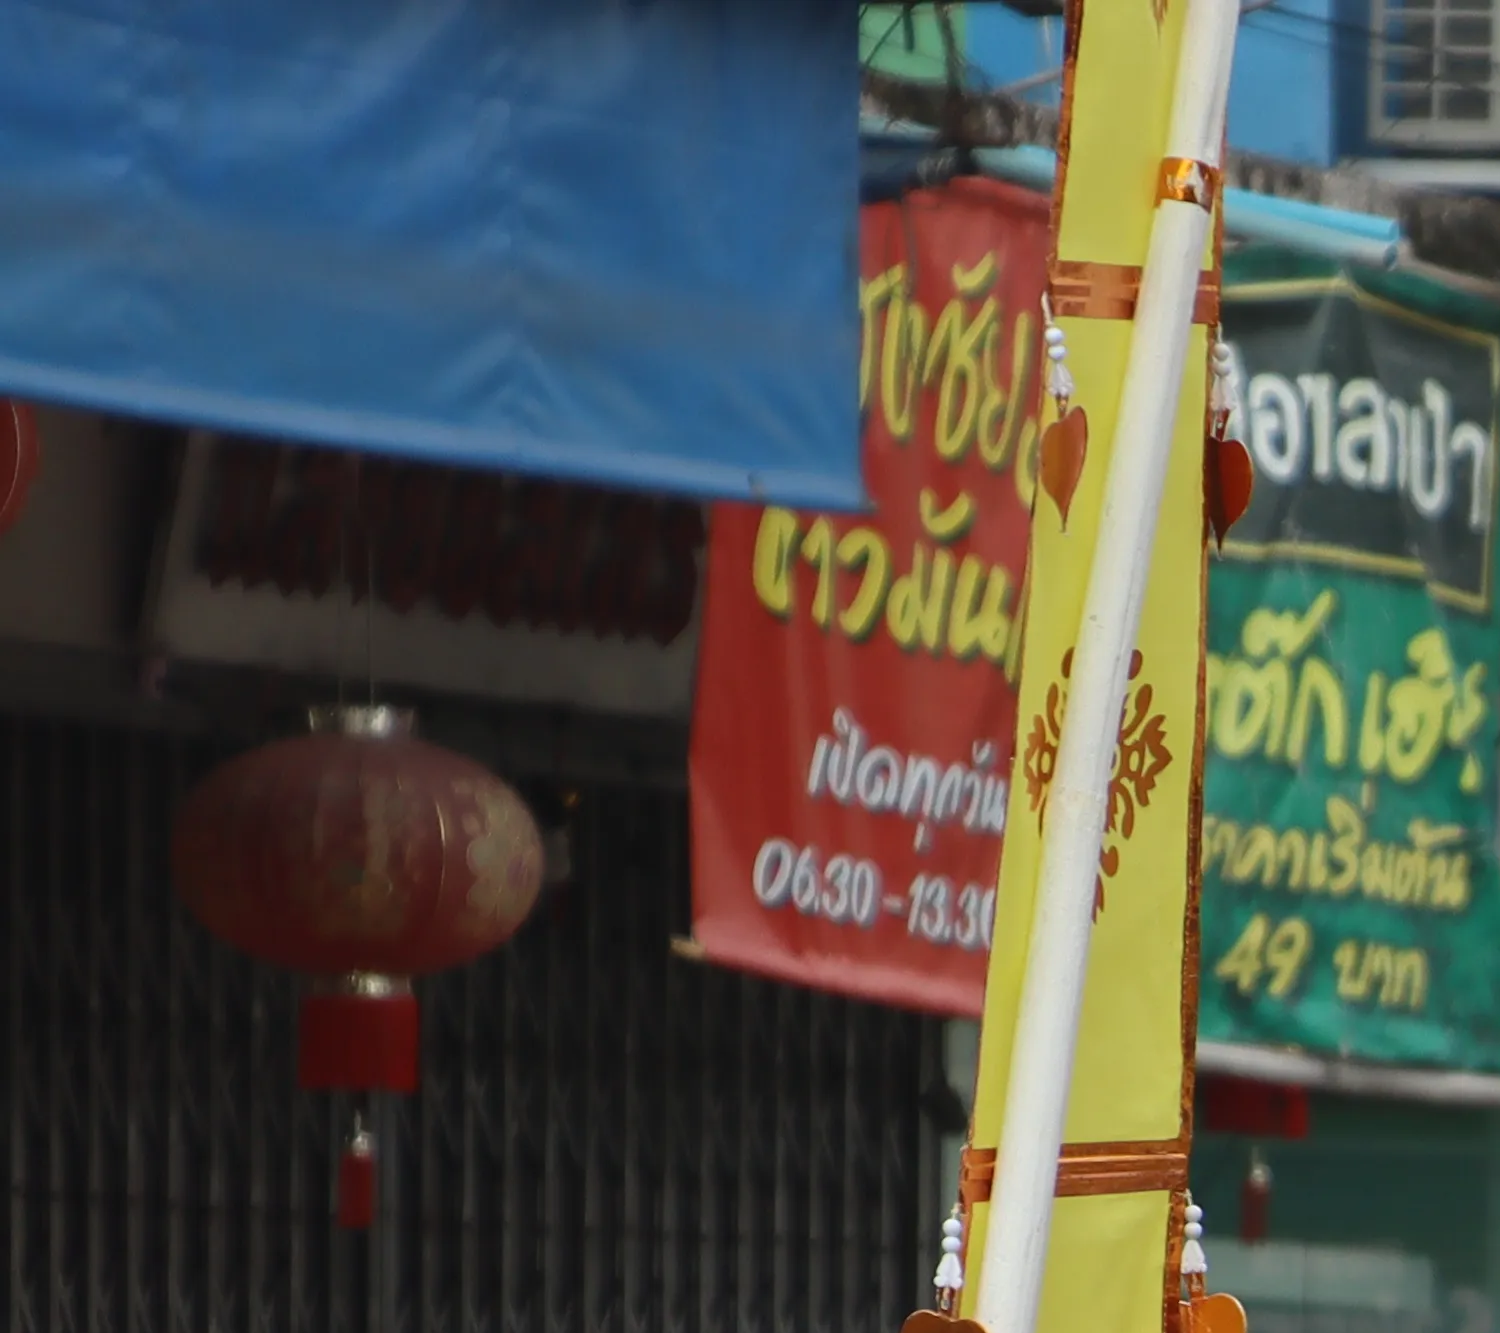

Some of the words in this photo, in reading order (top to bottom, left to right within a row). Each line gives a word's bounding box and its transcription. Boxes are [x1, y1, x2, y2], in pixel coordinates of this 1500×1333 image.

[807, 704, 1006, 850] เปิดทุกวัน
[1214, 912, 1311, 996] 49
